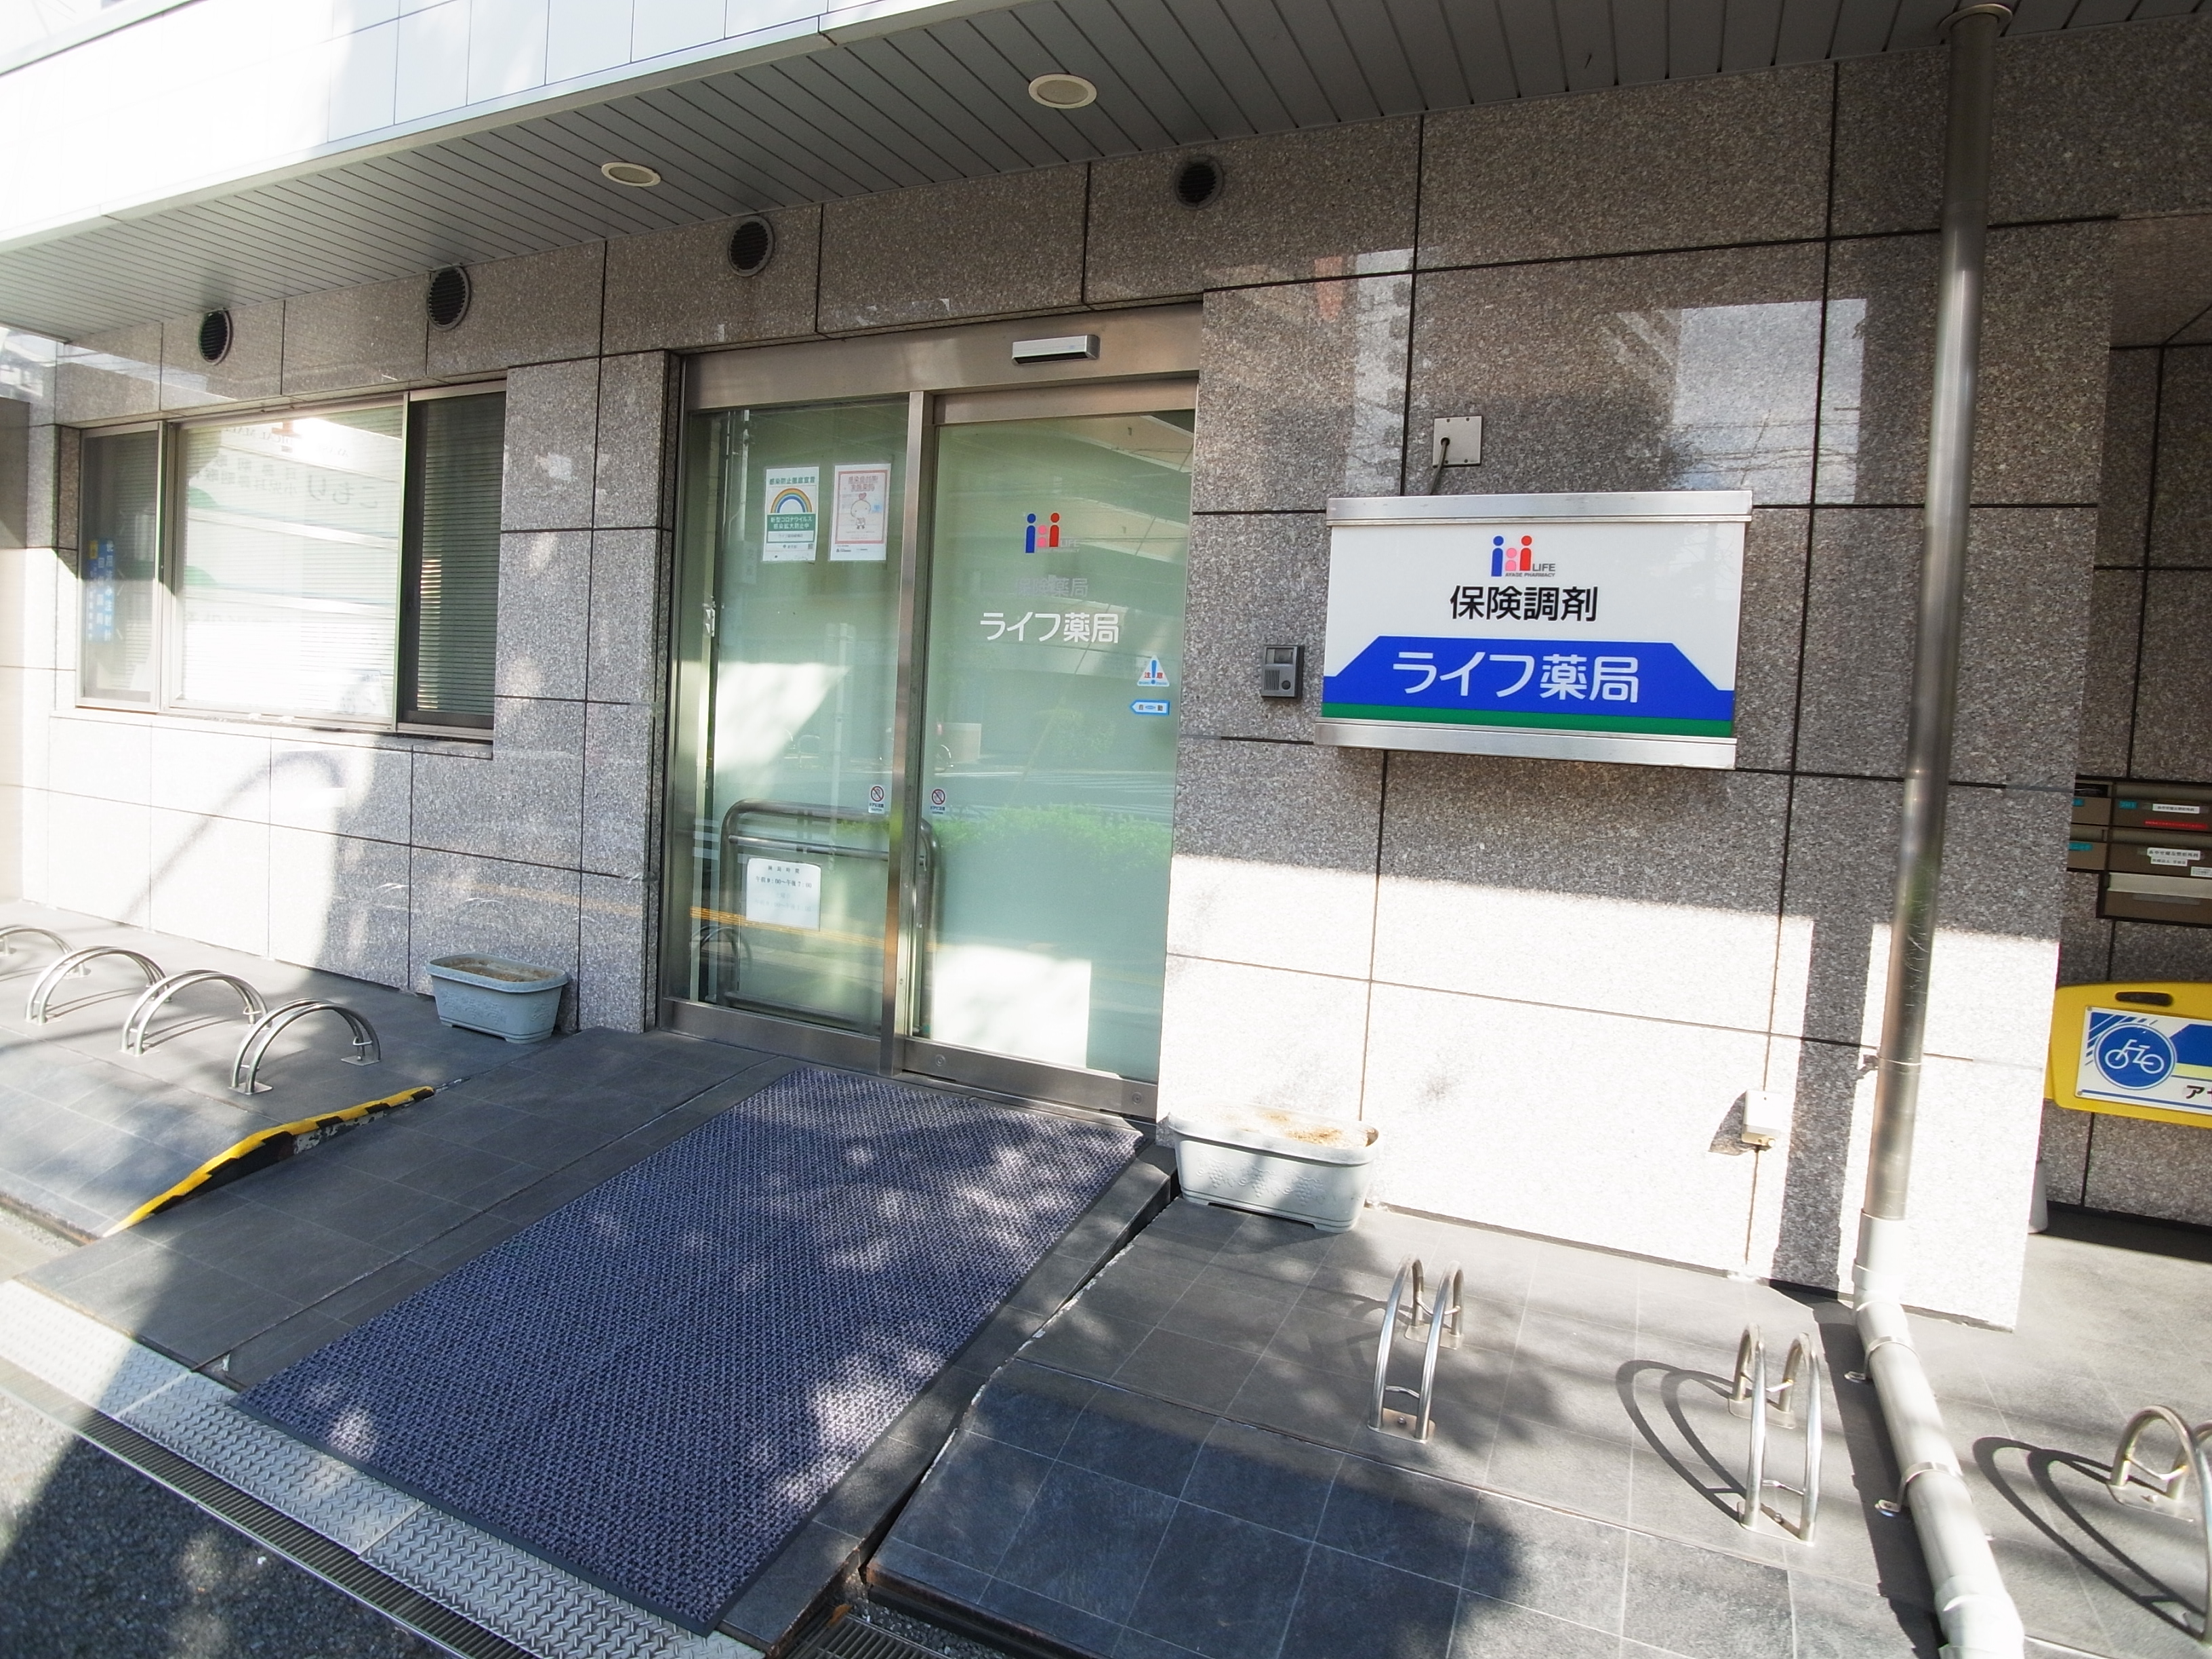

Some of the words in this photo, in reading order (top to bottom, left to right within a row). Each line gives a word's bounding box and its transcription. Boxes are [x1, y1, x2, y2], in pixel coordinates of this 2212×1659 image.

[1532, 562, 1556, 572] LIFE
[1450, 585, 1599, 622] 保険調剤
[980, 611, 1119, 644] ライフ薬局
[1392, 651, 1639, 703] ライフ薬局
